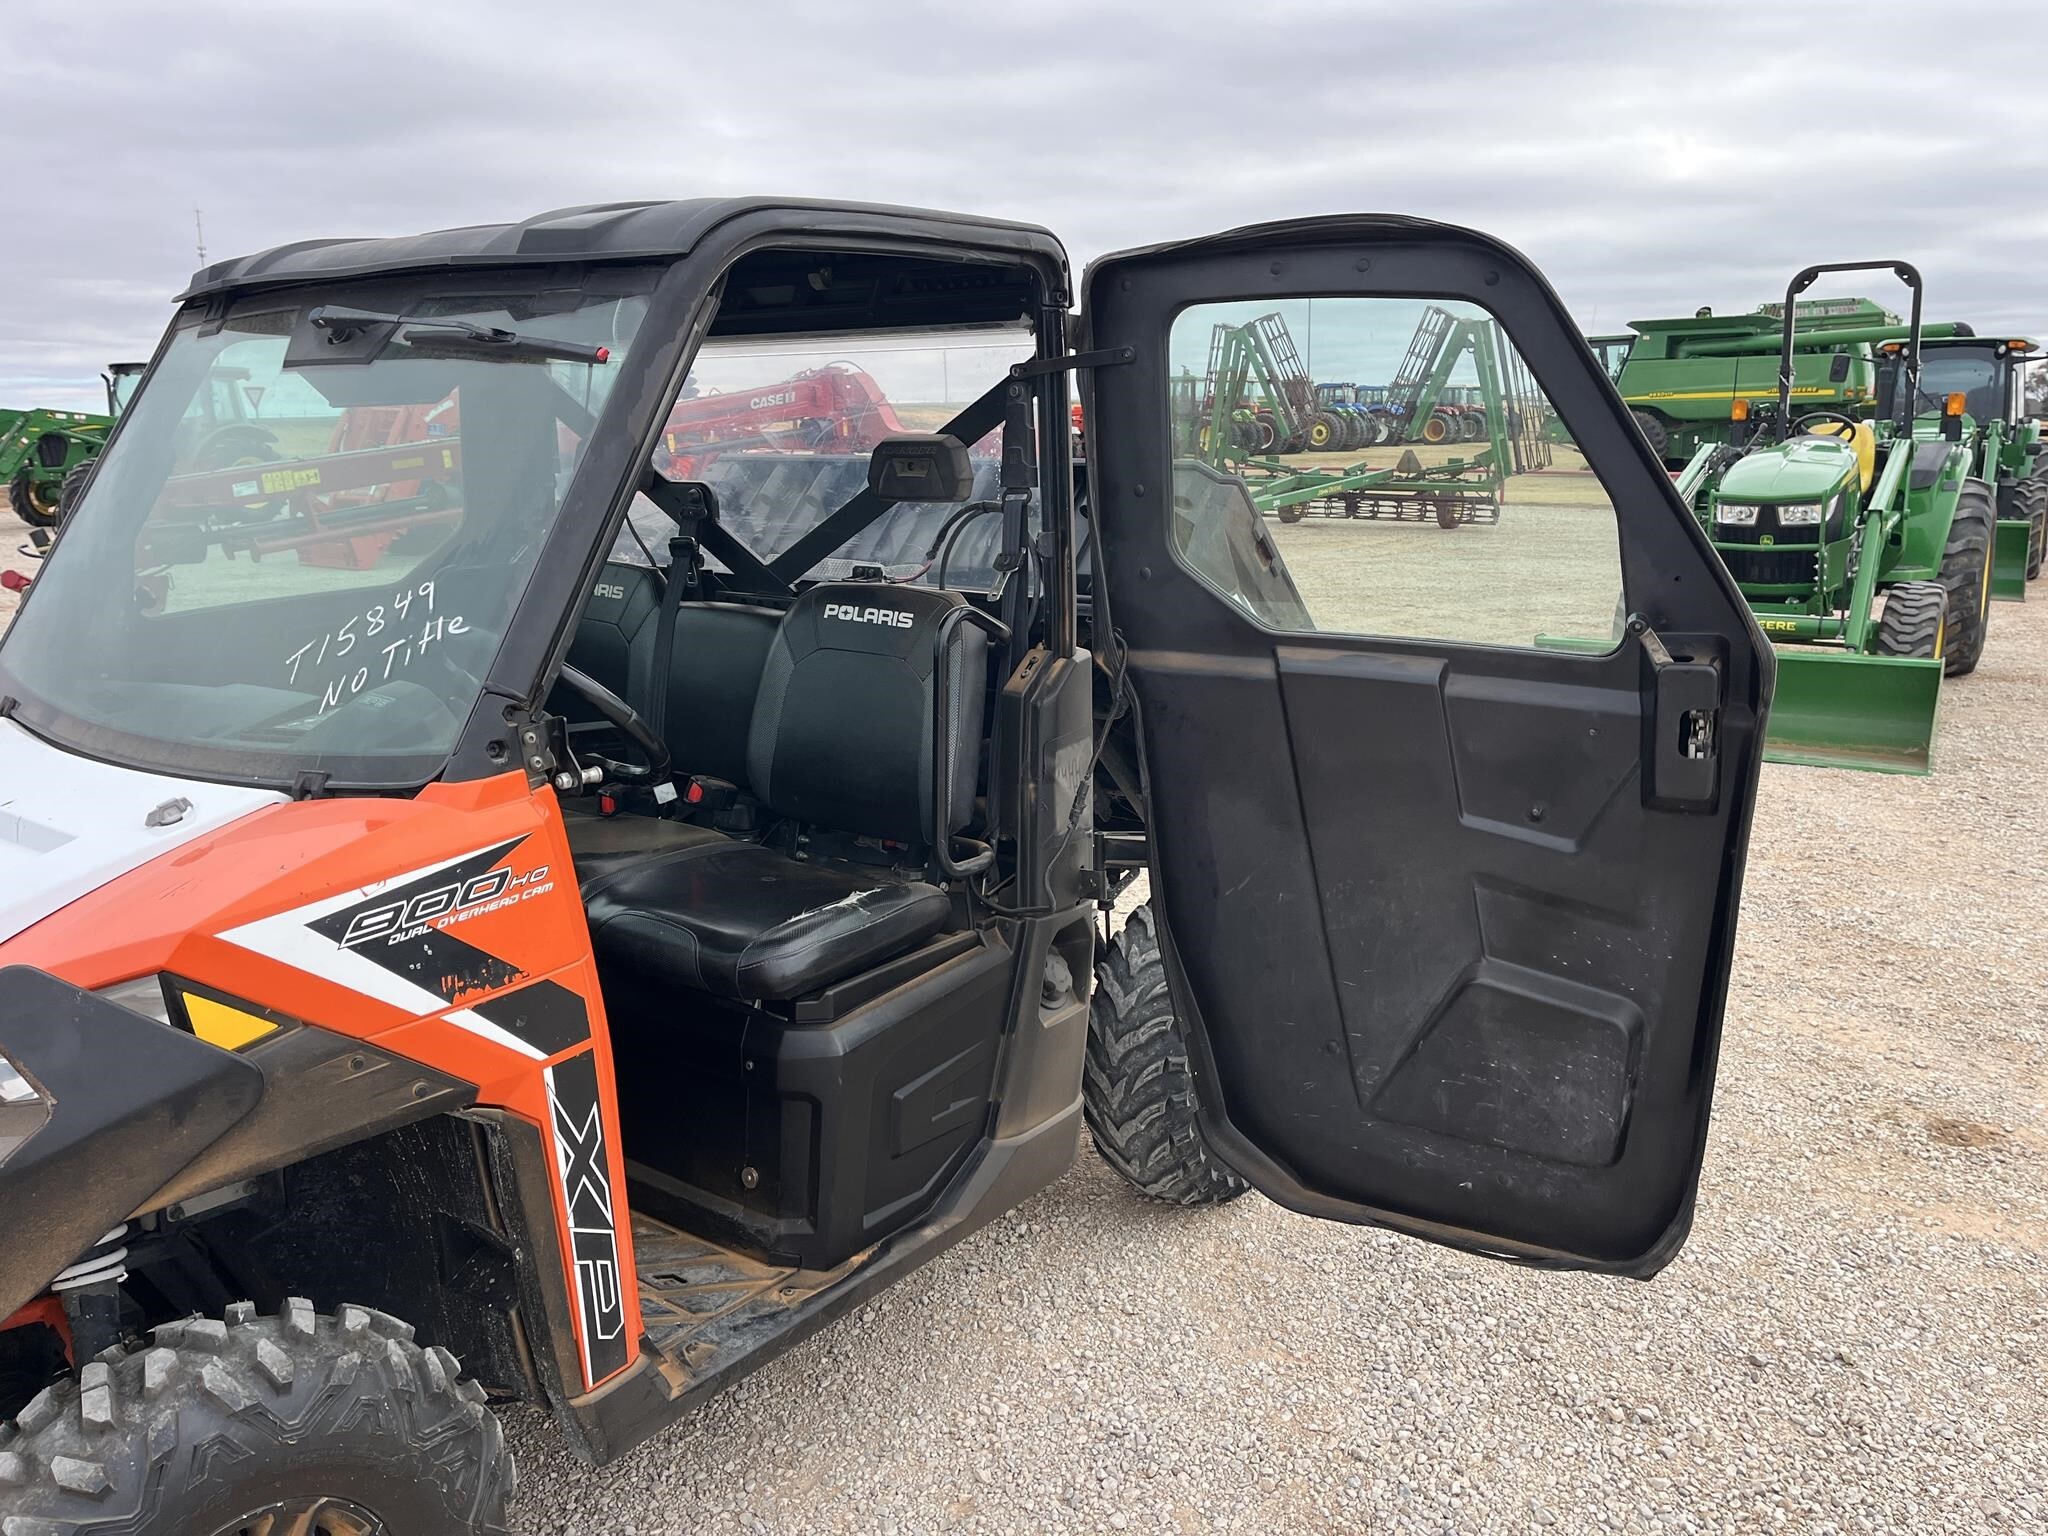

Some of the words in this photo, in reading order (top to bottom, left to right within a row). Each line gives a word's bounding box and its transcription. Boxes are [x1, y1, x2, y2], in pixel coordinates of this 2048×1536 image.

[750, 393, 784, 409] CASE
[285, 580, 435, 685] T15849
[823, 603, 914, 629] POLARIS
[1757, 620, 1796, 630] EERE
[338, 866, 512, 950] 900
[510, 865, 550, 891] HO
[387, 924, 433, 946] DUAL
[436, 894, 519, 930] OVERHEAD
[521, 881, 554, 900] CAM
[547, 1083, 625, 1339] XP
